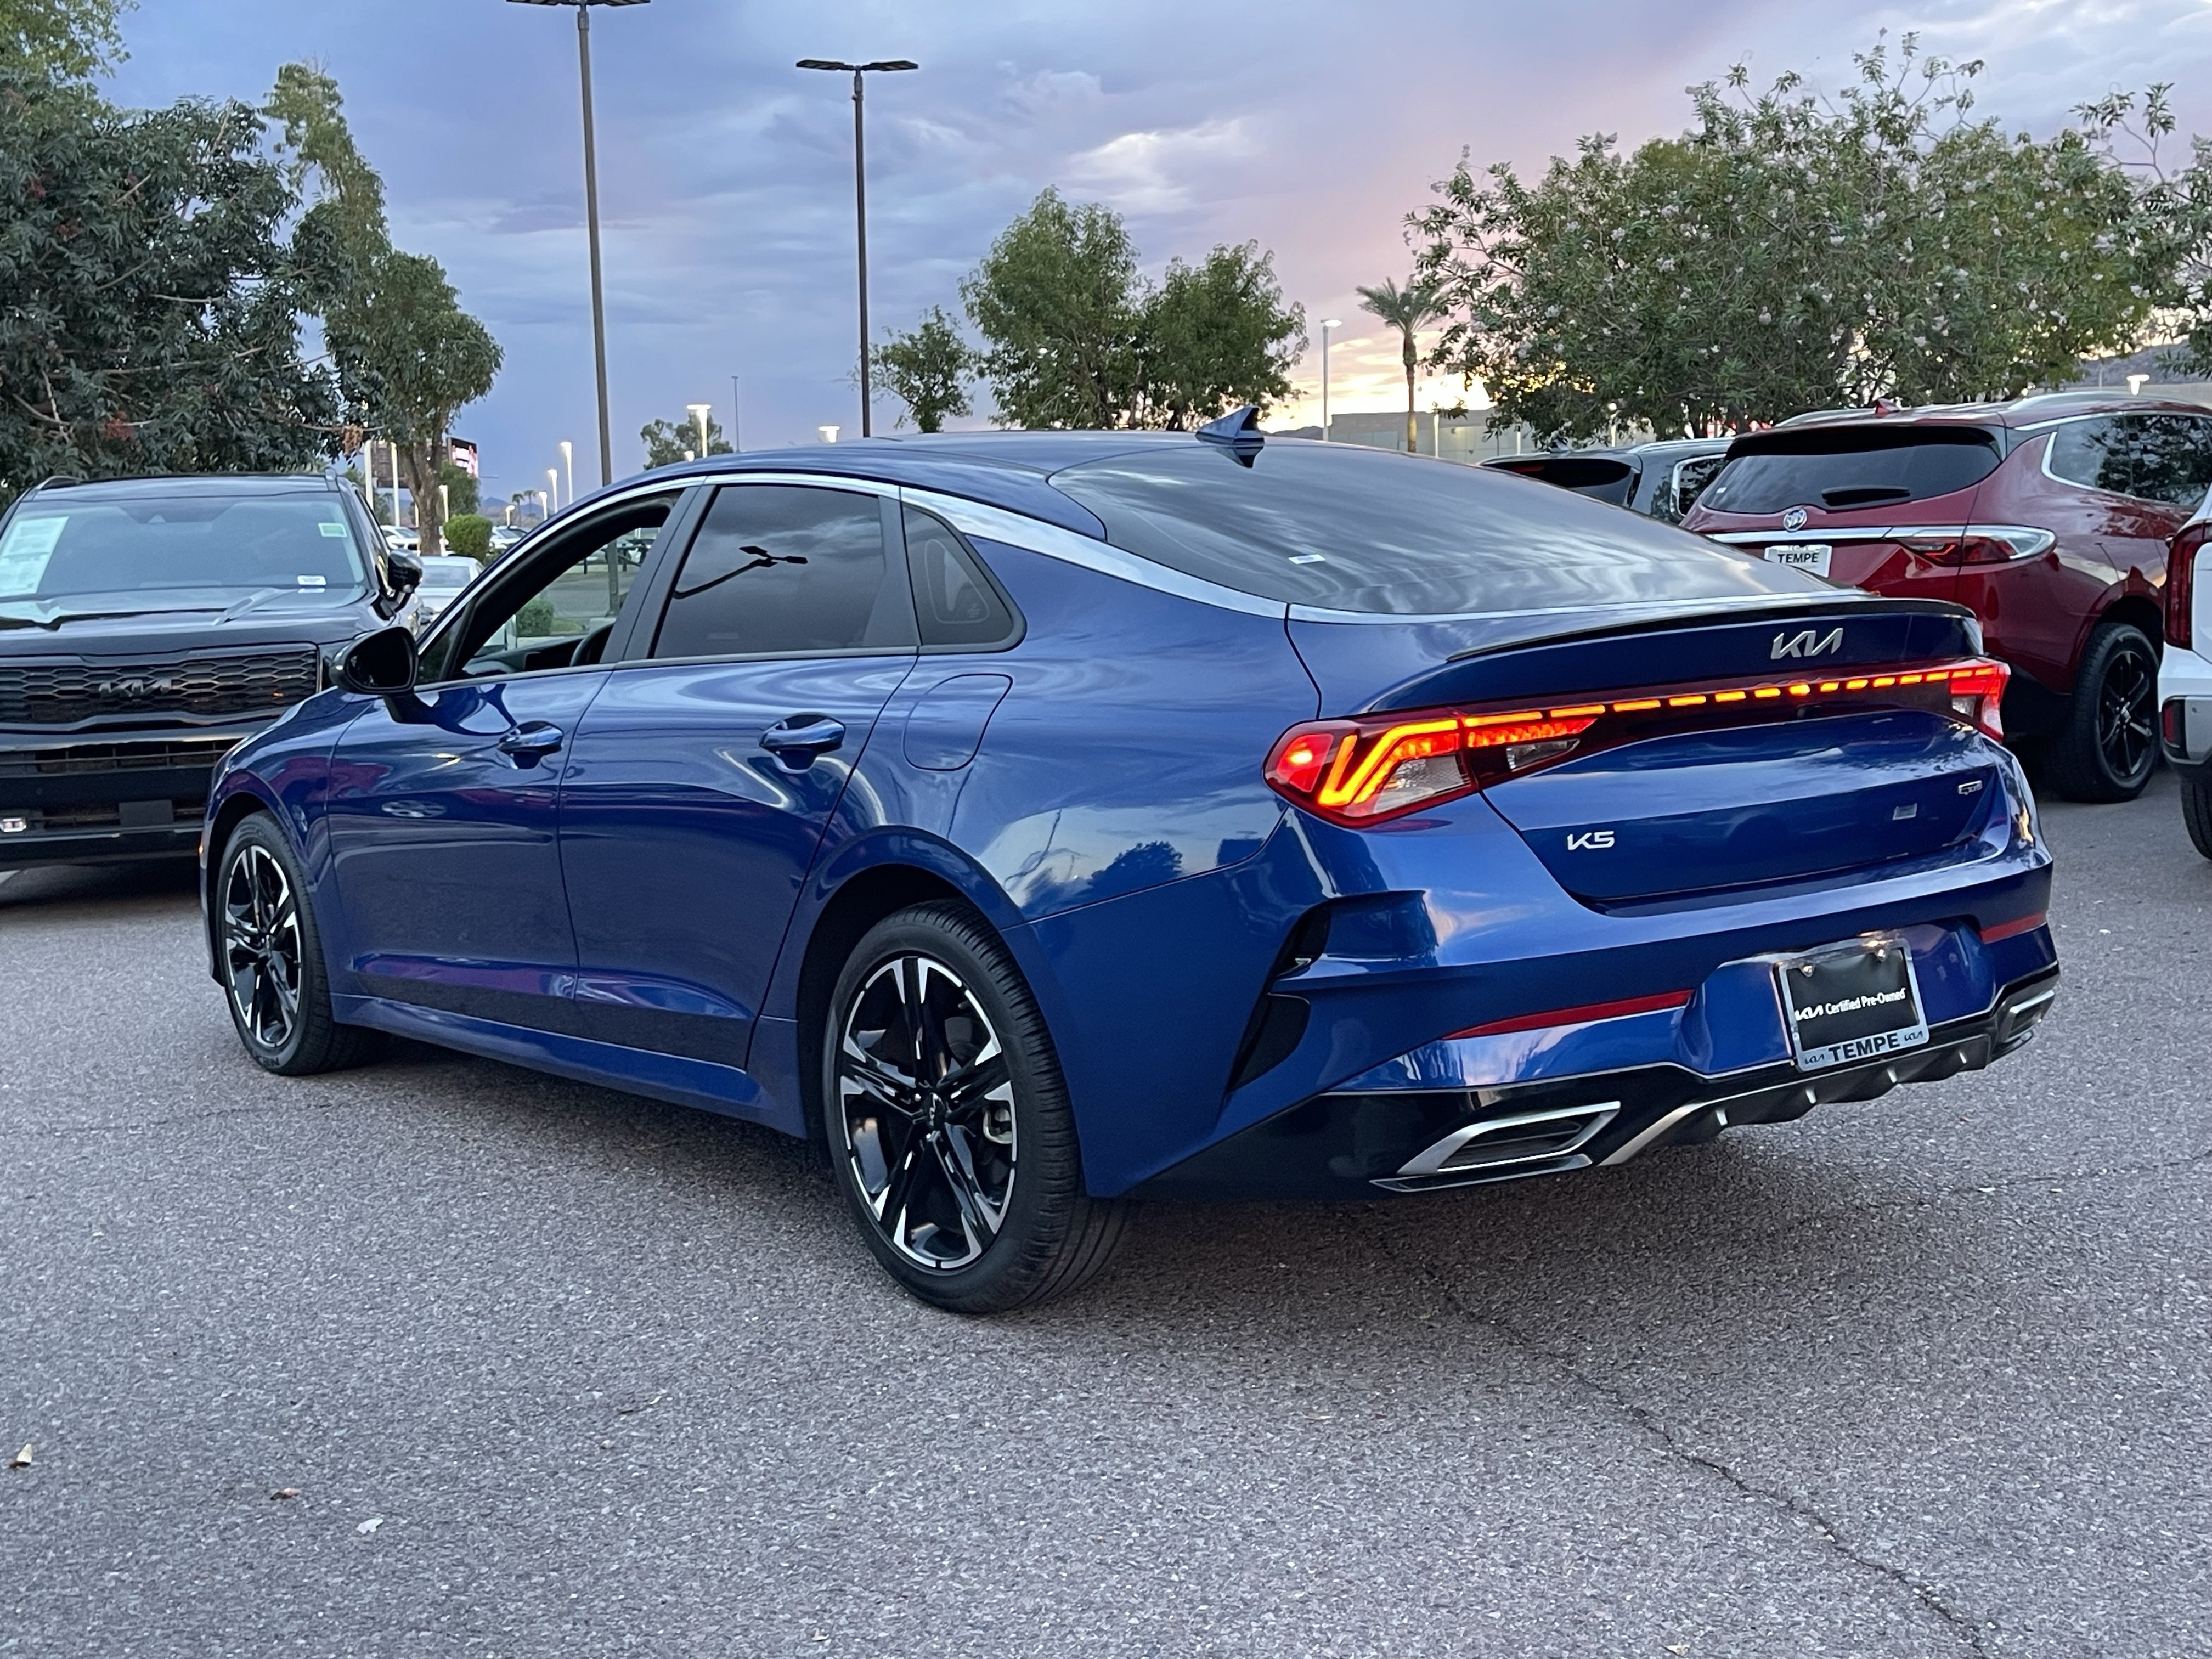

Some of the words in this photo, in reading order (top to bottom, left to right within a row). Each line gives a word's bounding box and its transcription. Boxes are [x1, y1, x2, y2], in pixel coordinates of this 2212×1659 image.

[1778, 552, 1820, 564] TEMPE
[1770, 627, 1844, 660] KIA
[1567, 831, 1615, 850] K5
[1795, 1004, 1824, 1021] KIA
[1825, 997, 1861, 1015] Certified
[1860, 987, 1906, 1008] Pre-Owned
[1804, 1053, 1825, 1065] KIA
[1828, 1032, 1900, 1062] TEMPE
[1904, 1030, 1923, 1042] KIA
